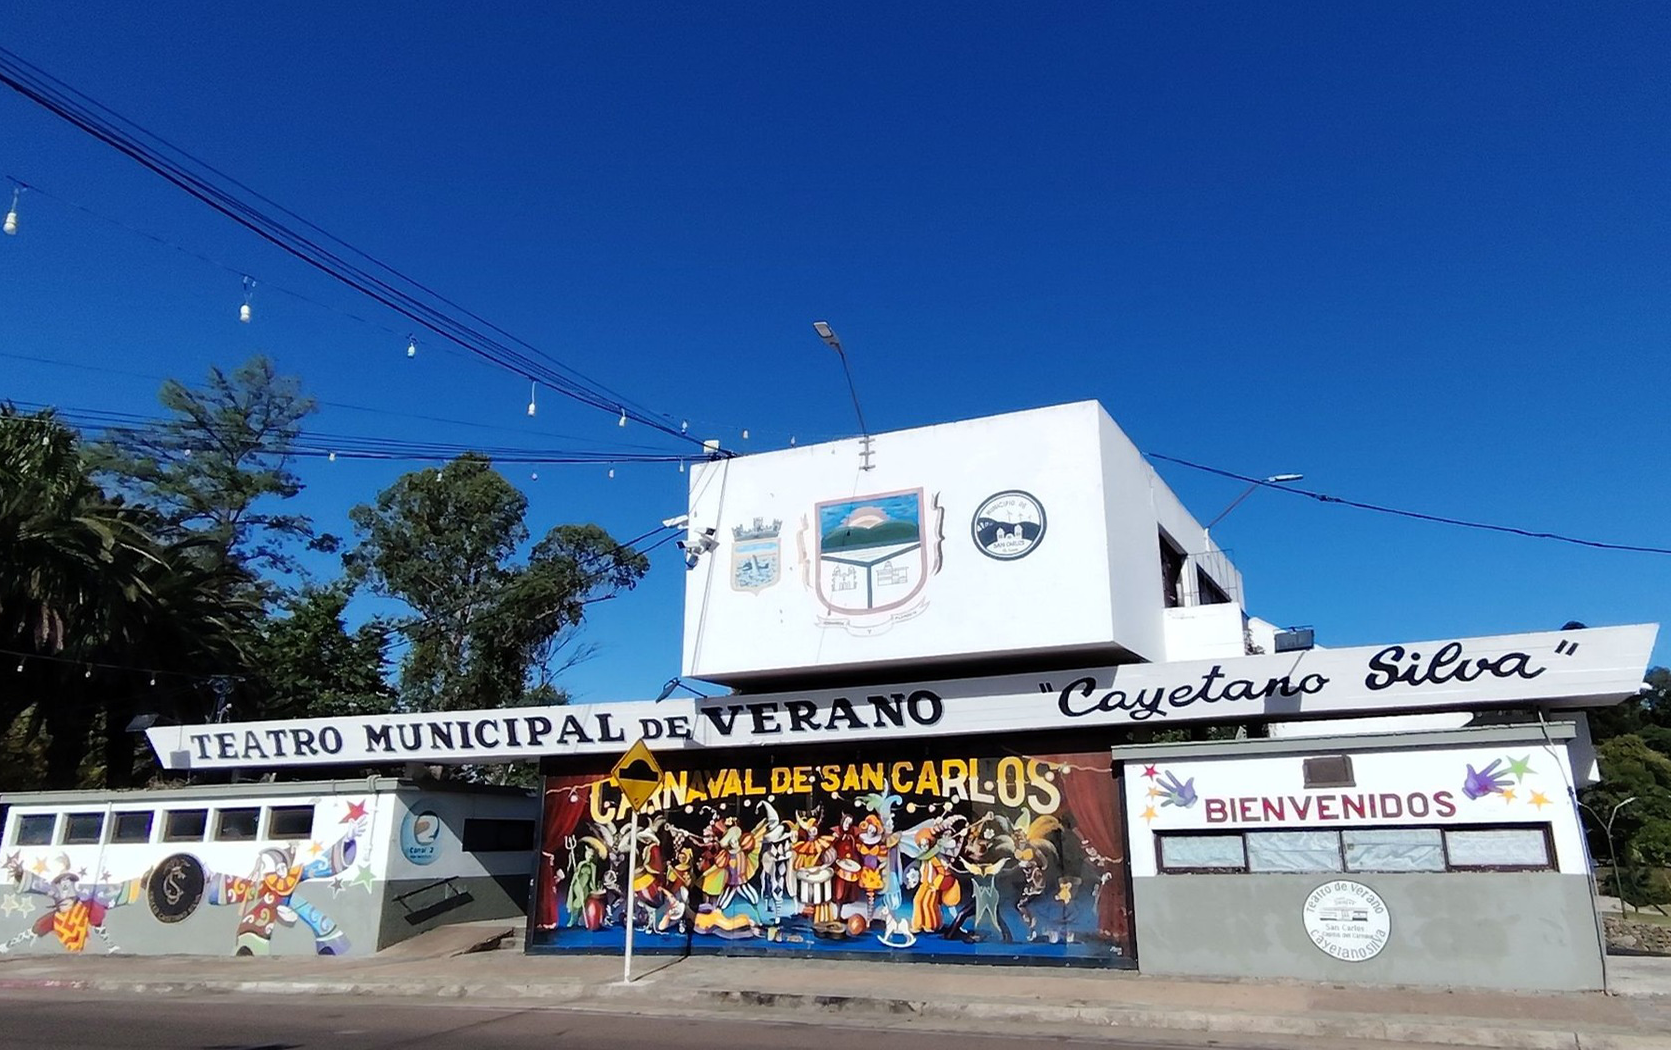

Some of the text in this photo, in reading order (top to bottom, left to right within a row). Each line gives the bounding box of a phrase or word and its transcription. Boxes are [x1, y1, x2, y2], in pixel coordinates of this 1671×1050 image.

[190, 726, 343, 759] TEATRO
[362, 713, 624, 752] MUNICIPAL
[639, 716, 691, 740] DE
[701, 690, 944, 735] VERANO
[771, 766, 812, 794] DE
[820, 762, 884, 792] SAN
[891, 756, 1060, 815] CARLOS
[1204, 791, 1456, 823] BIENVENIDOS
[1334, 882, 1347, 891] de
[1325, 923, 1340, 931] San
